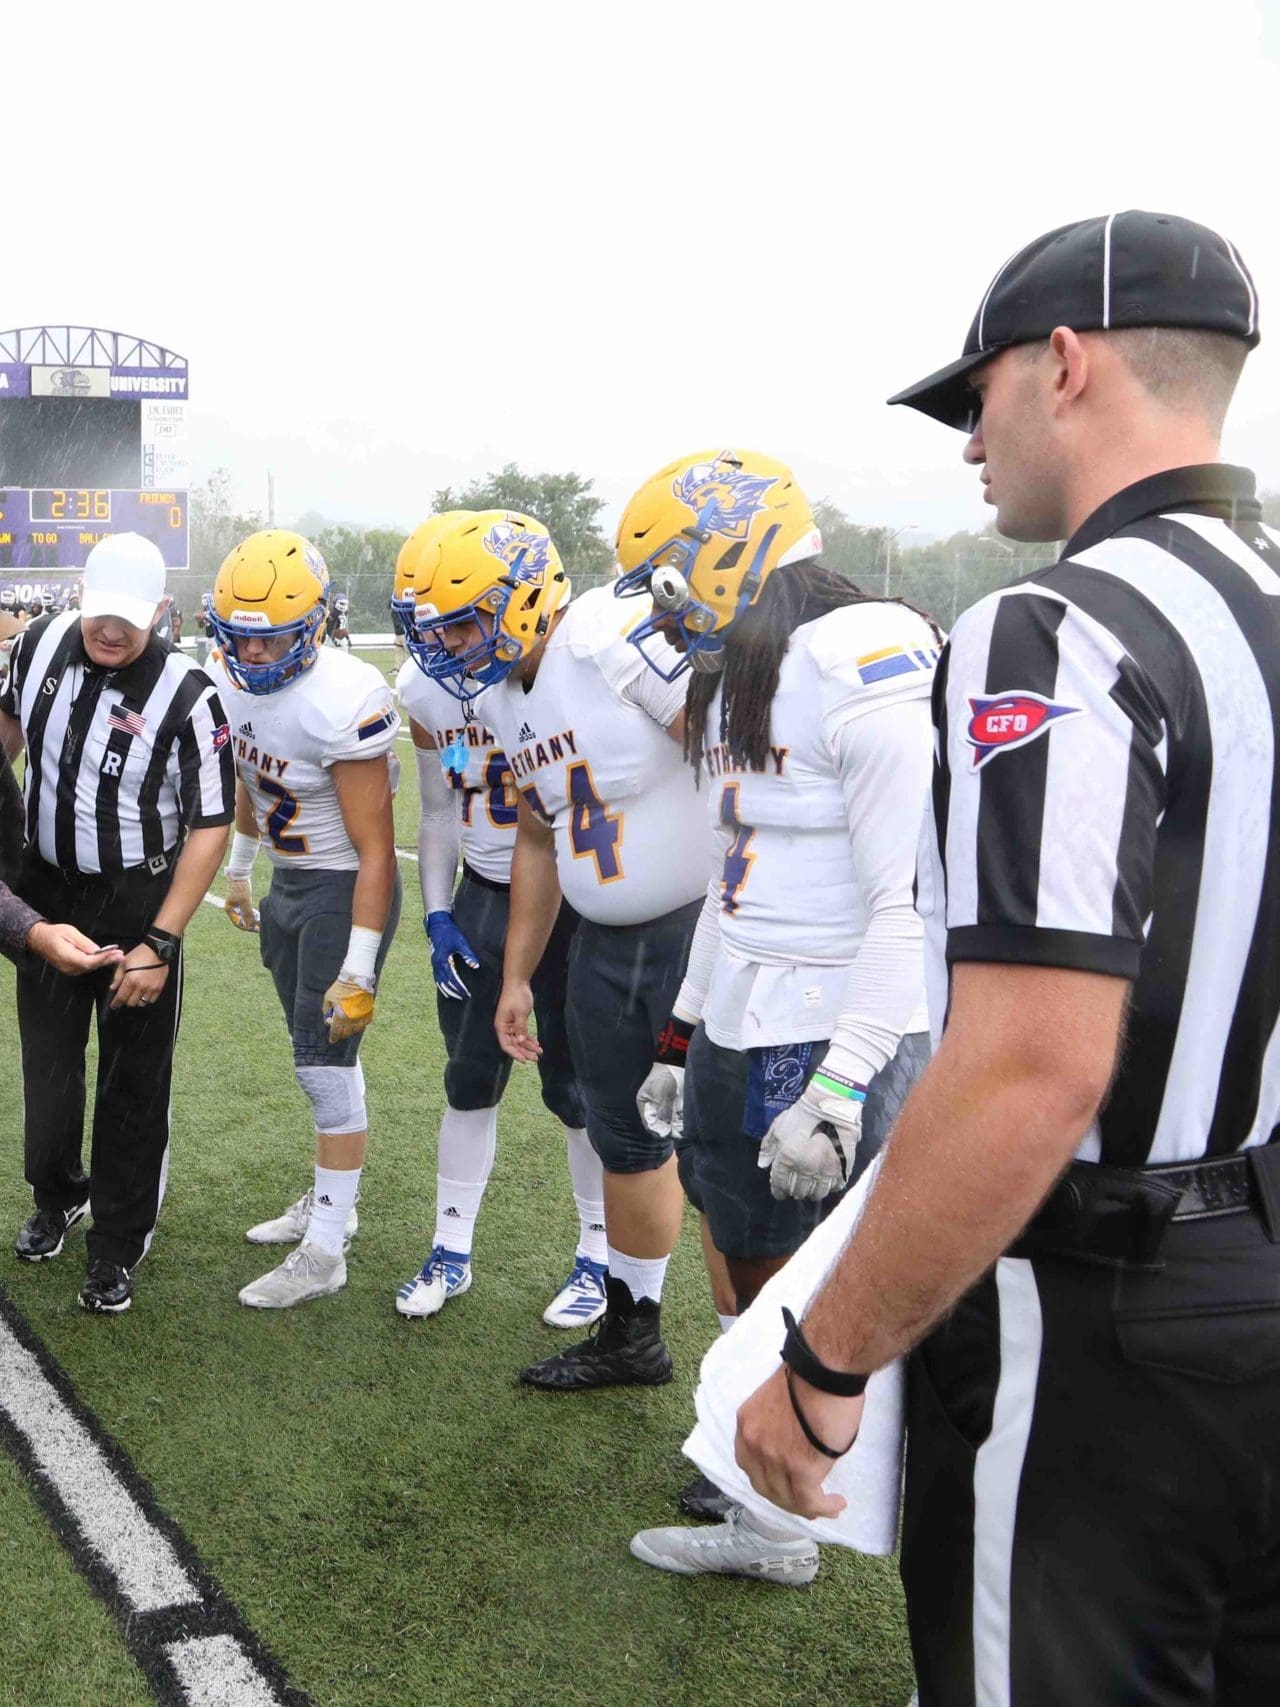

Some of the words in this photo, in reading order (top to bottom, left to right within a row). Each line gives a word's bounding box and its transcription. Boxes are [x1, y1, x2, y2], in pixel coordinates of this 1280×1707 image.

[110, 376, 187, 393] UNIVERSITY
[51, 490, 108, 518] 2:36
[139, 492, 177, 504] FRIENDS
[169, 506, 182, 528] 0
[42, 677, 58, 696] S
[985, 714, 1028, 733] CFO
[436, 726, 496, 748] BETHA
[101, 749, 122, 777] R
[232, 735, 289, 778] THANY
[510, 728, 577, 780] ETHANY
[255, 770, 312, 857] 2
